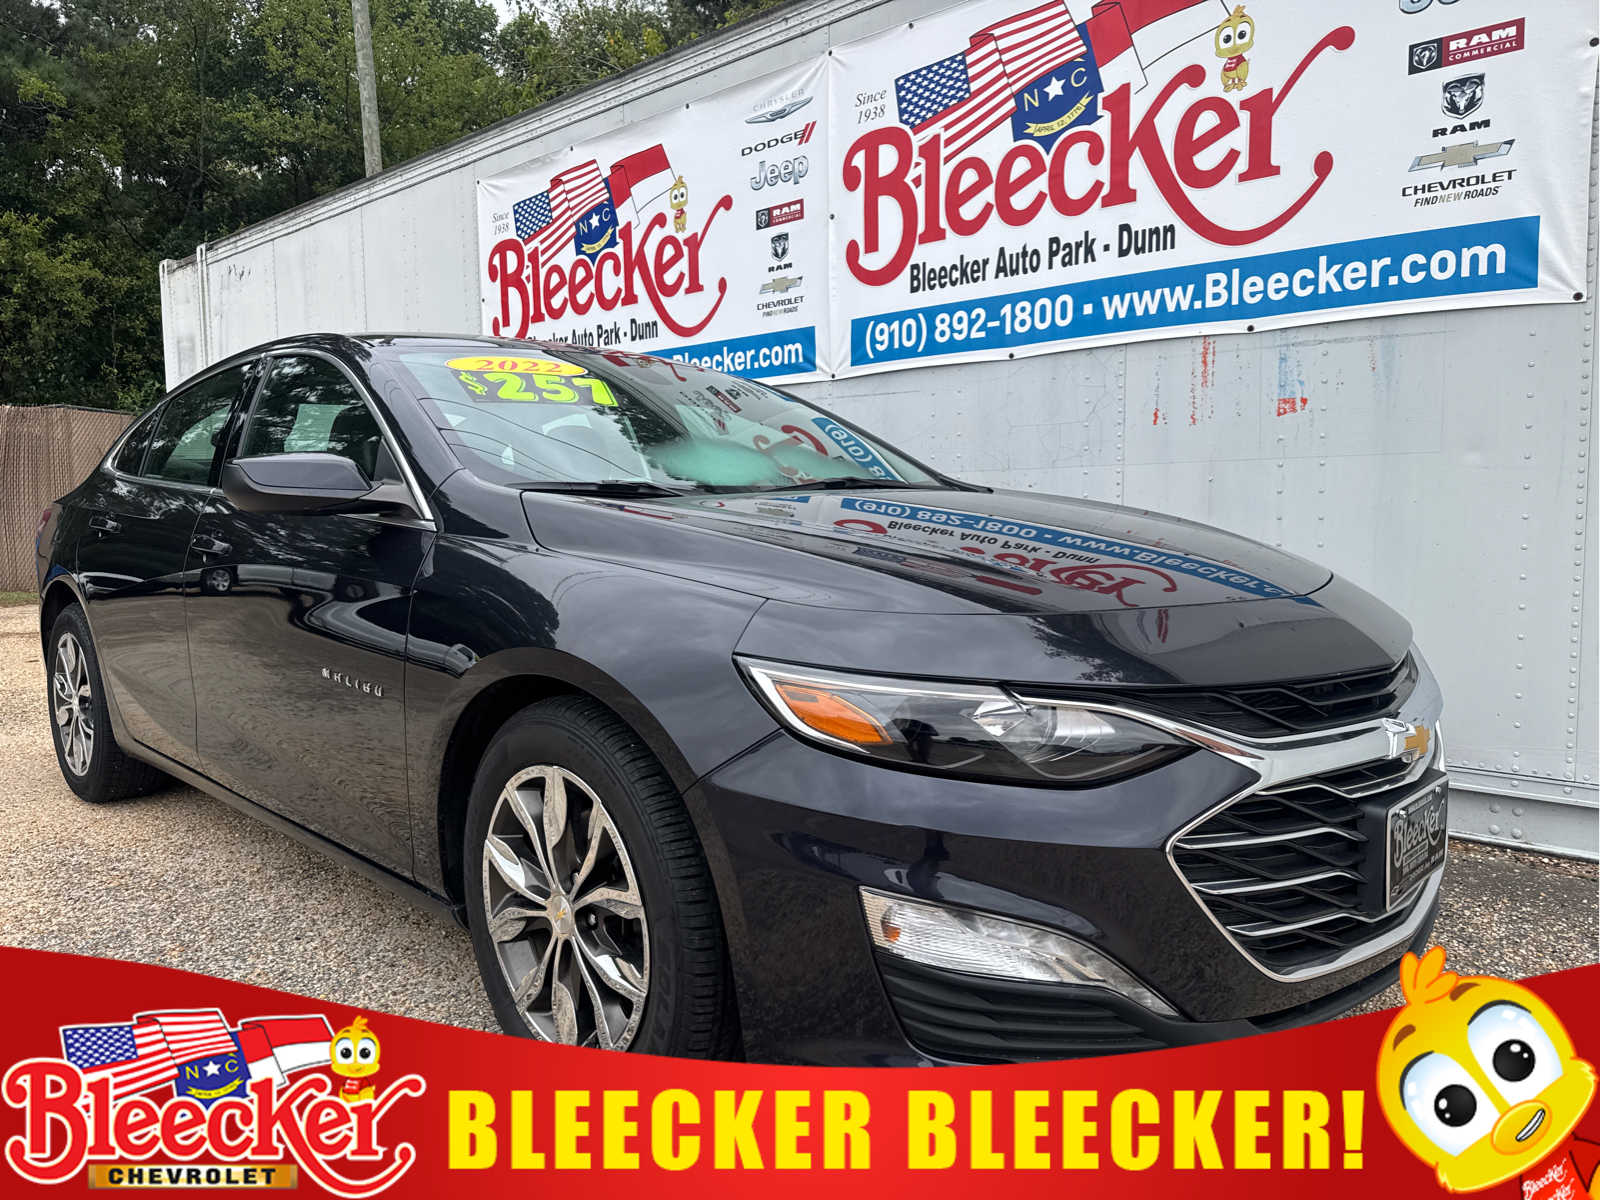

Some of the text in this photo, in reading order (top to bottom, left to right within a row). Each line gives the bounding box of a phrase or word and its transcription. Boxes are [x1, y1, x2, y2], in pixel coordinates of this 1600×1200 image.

[1448, 25, 1517, 51] RAM
[1448, 40, 1517, 61] COMMERCIAL
[855, 88, 887, 108] Since
[1023, 67, 1087, 112] N C
[857, 104, 886, 125] 1938
[1432, 119, 1491, 138] RAM
[741, 128, 806, 157] DODGE
[843, 26, 1356, 286] Bleecker
[750, 155, 809, 191] Jeep
[1401, 168, 1518, 198] CHEVROLET
[492, 212, 510, 223] Since
[772, 203, 801, 217] RAM
[494, 223, 510, 236] 1938
[488, 194, 733, 340] Bleecker
[768, 262, 793, 273] RAM
[909, 222, 1176, 294] Bleecker Auto Park Dunn
[756, 295, 805, 311] CHEVROLET
[865, 242, 1507, 359] (910) 892-1800 www.Bleecker.com
[571, 328, 594, 346] Auto
[596, 320, 621, 347] Park
[630, 318, 659, 342] Dunn
[475, 359, 563, 373] 2022
[458, 371, 619, 407] $257
[321, 667, 382, 697] MALIBU
